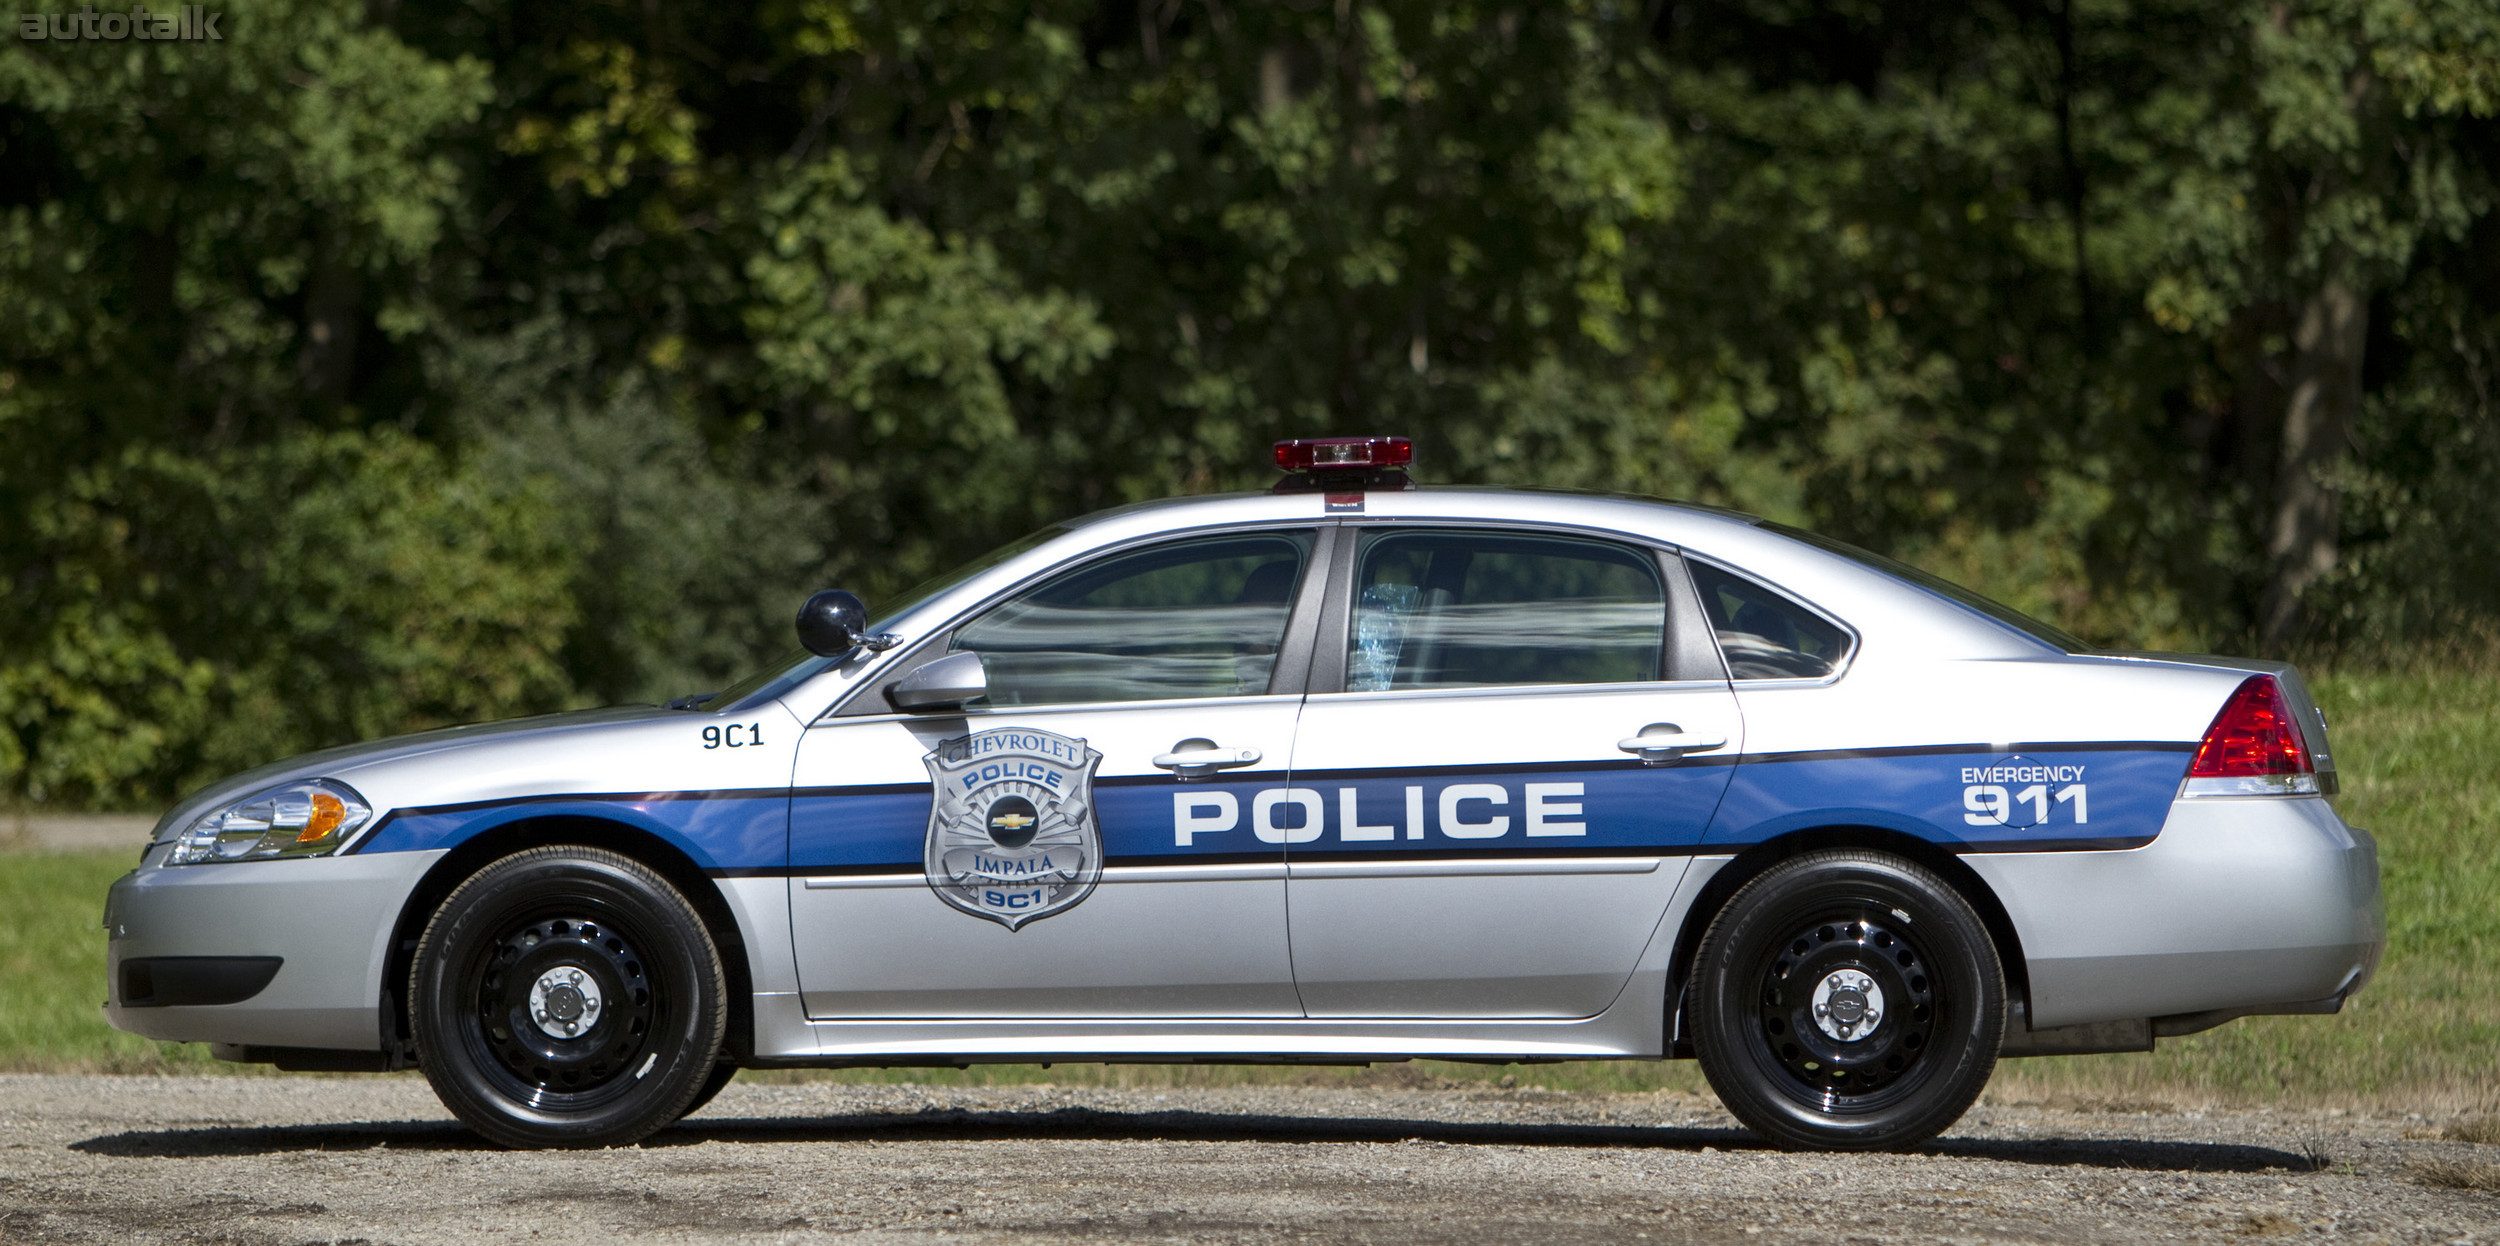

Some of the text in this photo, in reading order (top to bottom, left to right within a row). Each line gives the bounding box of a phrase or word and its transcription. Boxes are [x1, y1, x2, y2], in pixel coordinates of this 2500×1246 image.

[702, 722, 764, 749] 9C1
[947, 734, 1078, 763] CHEVROLET
[962, 762, 1063, 790] POLICE
[1961, 765, 2086, 783] EMERGENCY
[1173, 782, 1587, 848] POLICE
[1963, 784, 2088, 826] 911
[974, 854, 1054, 876] IMPALA
[985, 889, 1042, 909] 9C1
